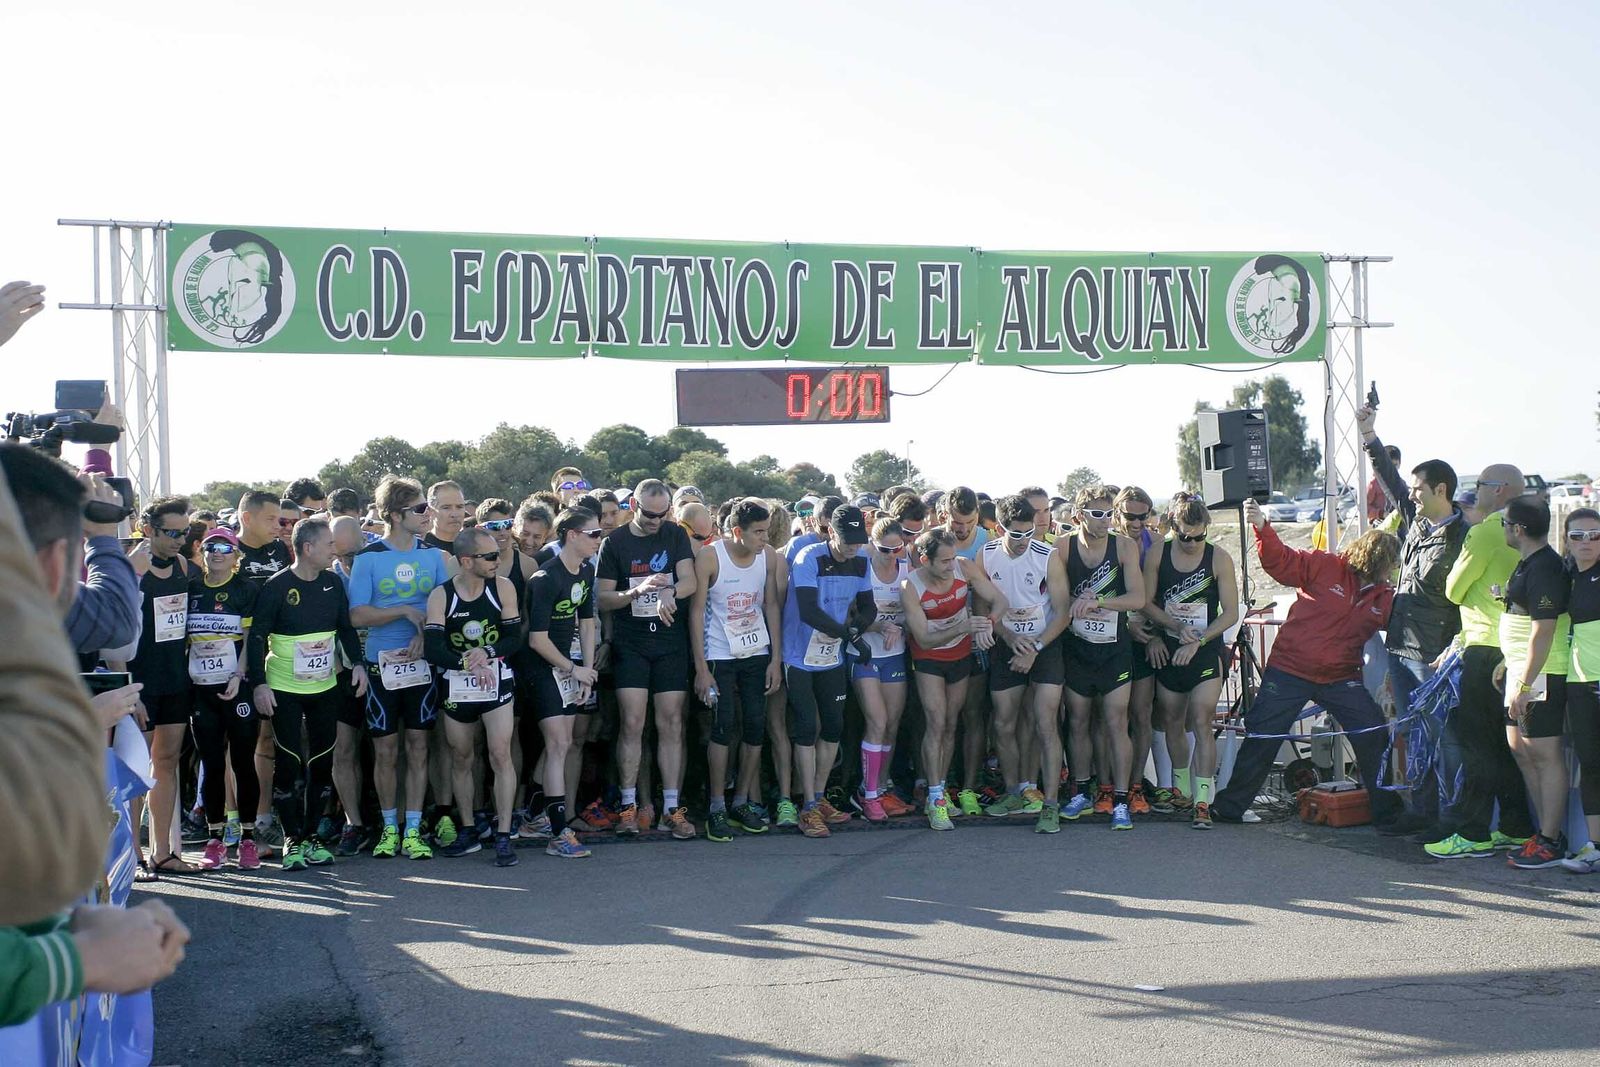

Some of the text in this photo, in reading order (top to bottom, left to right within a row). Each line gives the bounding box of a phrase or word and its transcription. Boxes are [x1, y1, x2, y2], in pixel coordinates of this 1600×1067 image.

[316, 245, 1210, 361] C.D. ESPARTANOS DE EL ALQUIAN
[786, 373, 881, 418] 0:00
[397, 568, 413, 577] run
[167, 613, 185, 625] 413
[1013, 622, 1035, 633] 372
[1084, 621, 1105, 633] 332
[741, 632, 759, 647] 110
[200, 658, 224, 671] 134
[307, 656, 328, 669] 424
[393, 663, 417, 675] 275
